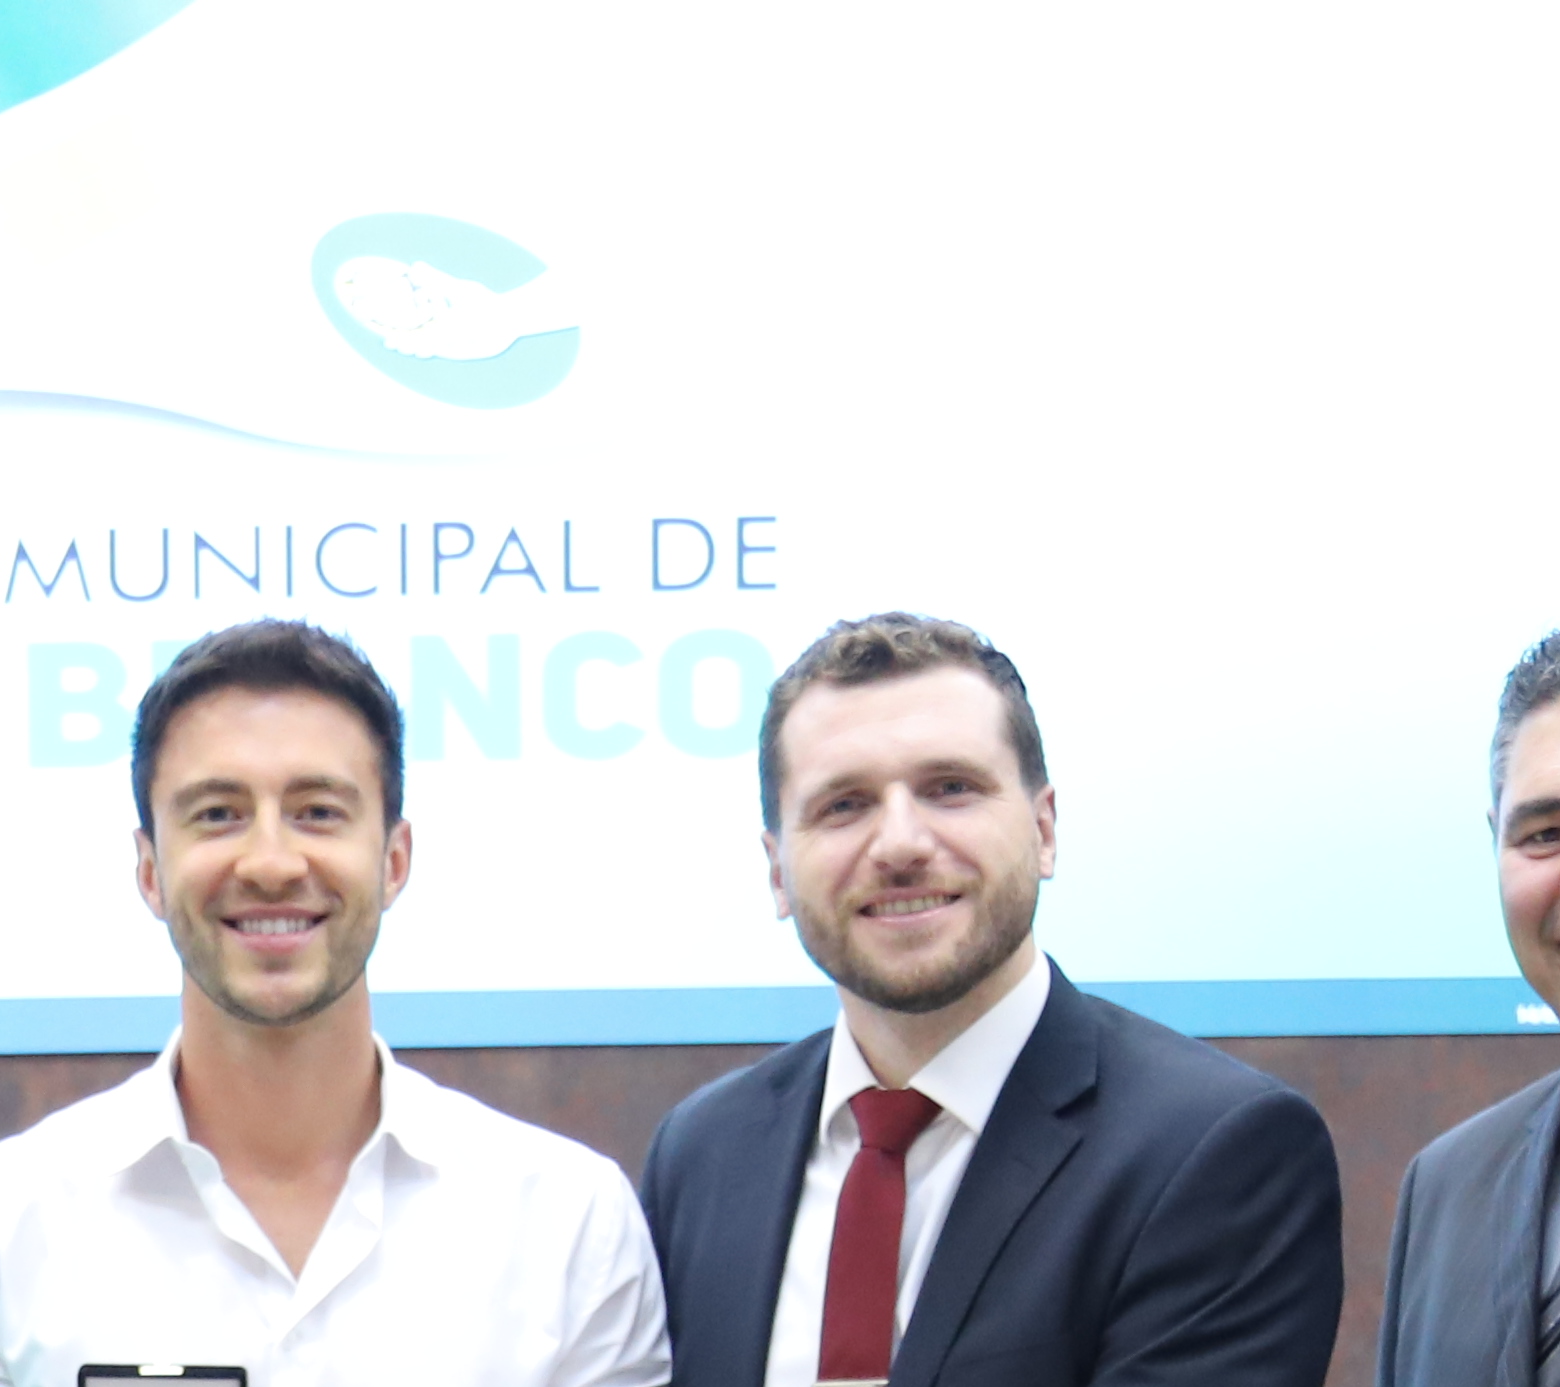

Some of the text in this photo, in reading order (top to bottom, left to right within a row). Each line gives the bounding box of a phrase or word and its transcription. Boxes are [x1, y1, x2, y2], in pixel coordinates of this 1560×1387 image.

[5, 521, 600, 601] MUNICIPAL
[651, 516, 778, 592] DE
[27, 628, 773, 767] BNCO
